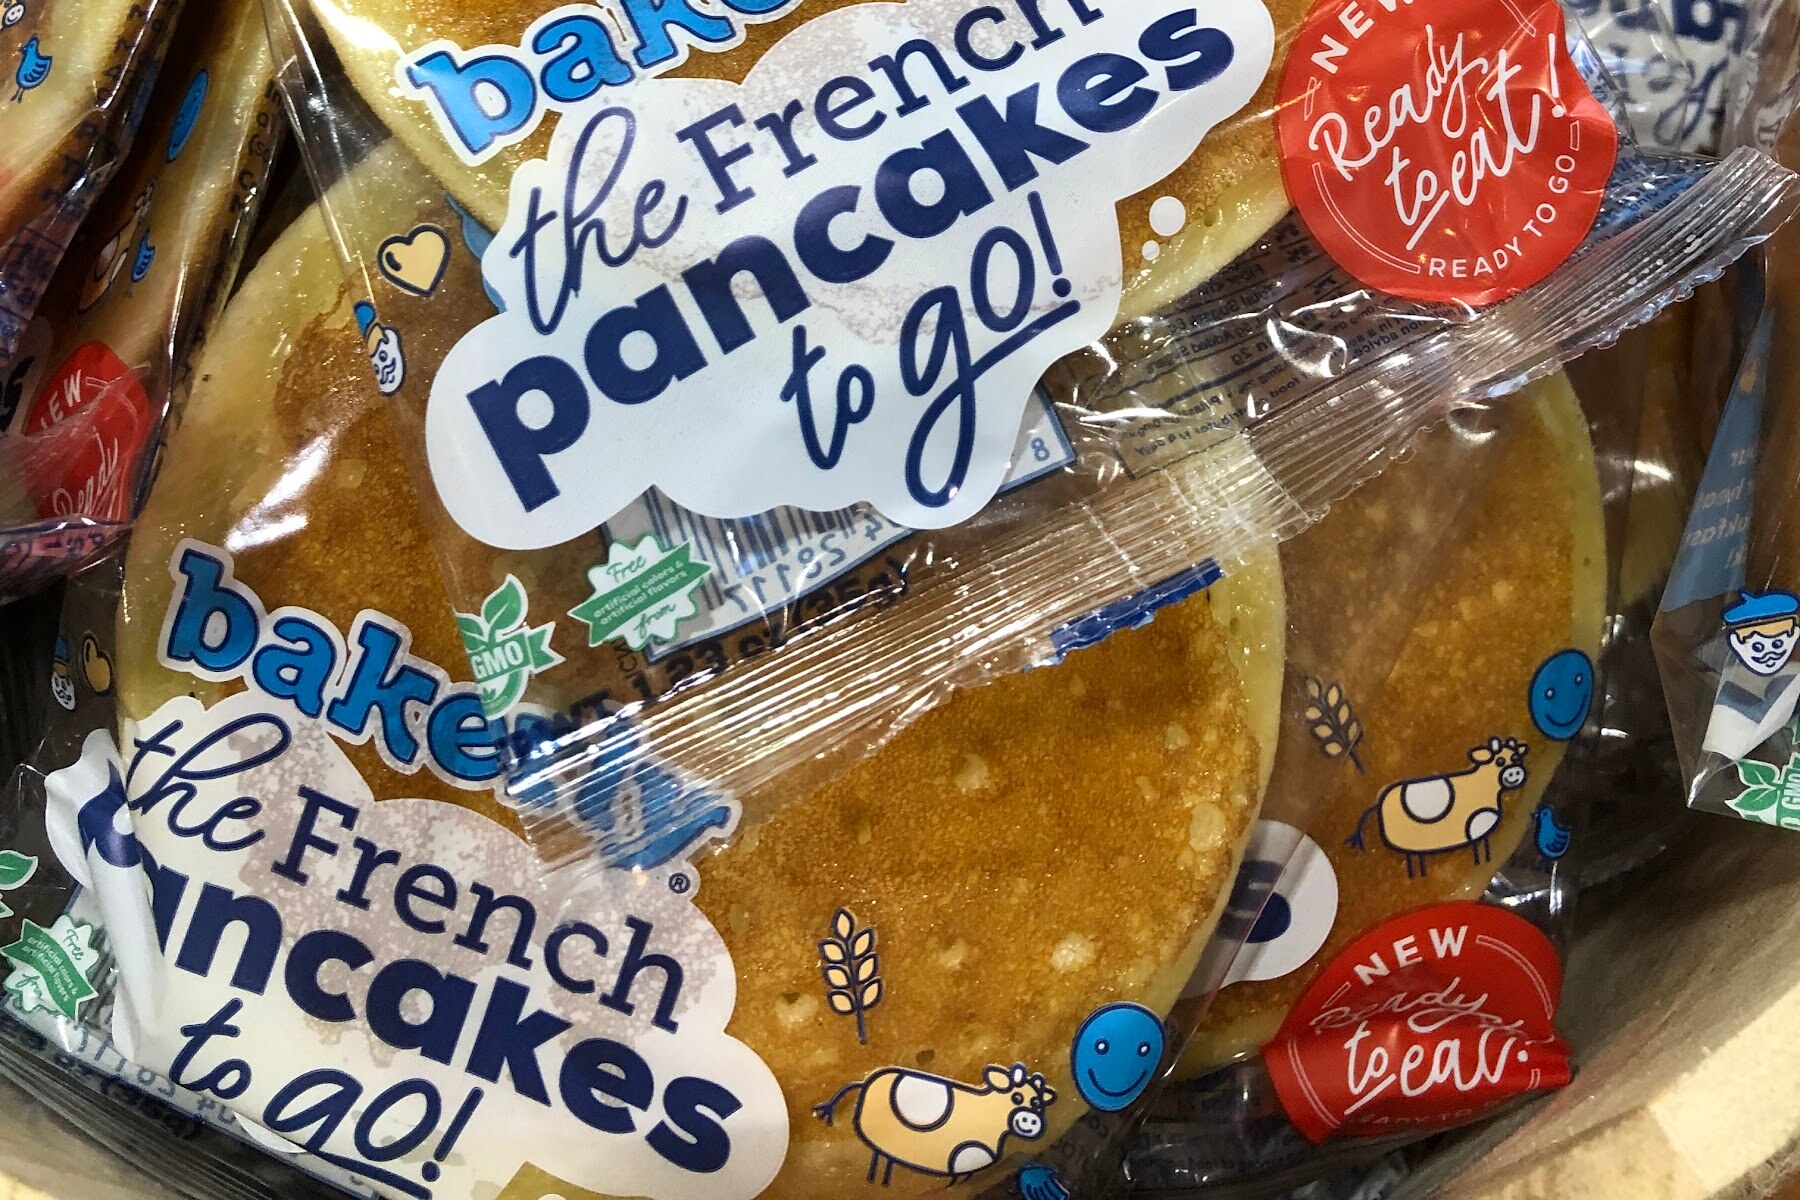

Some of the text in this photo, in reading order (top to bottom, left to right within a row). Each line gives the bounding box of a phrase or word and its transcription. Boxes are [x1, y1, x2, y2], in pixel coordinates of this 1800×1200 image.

[1308, 23, 1489, 182] Ready
[1384, 145, 1441, 227] to
[1451, 33, 1565, 206] eat!
[466, 8, 1234, 513] pancakes
[509, 105, 688, 335] the
[1428, 154, 1575, 278] READY TO GO
[779, 191, 1081, 508] to go!
[593, 585, 640, 618] artificial
[600, 593, 646, 625] artificial
[607, 555, 646, 582] Free
[470, 640, 524, 679] GMO
[127, 712, 686, 1033] the French
[1354, 925, 1468, 985] NEW
[169, 998, 252, 1100] to
[263, 1069, 484, 1199] go!
[1344, 1020, 1529, 1097] to eat
